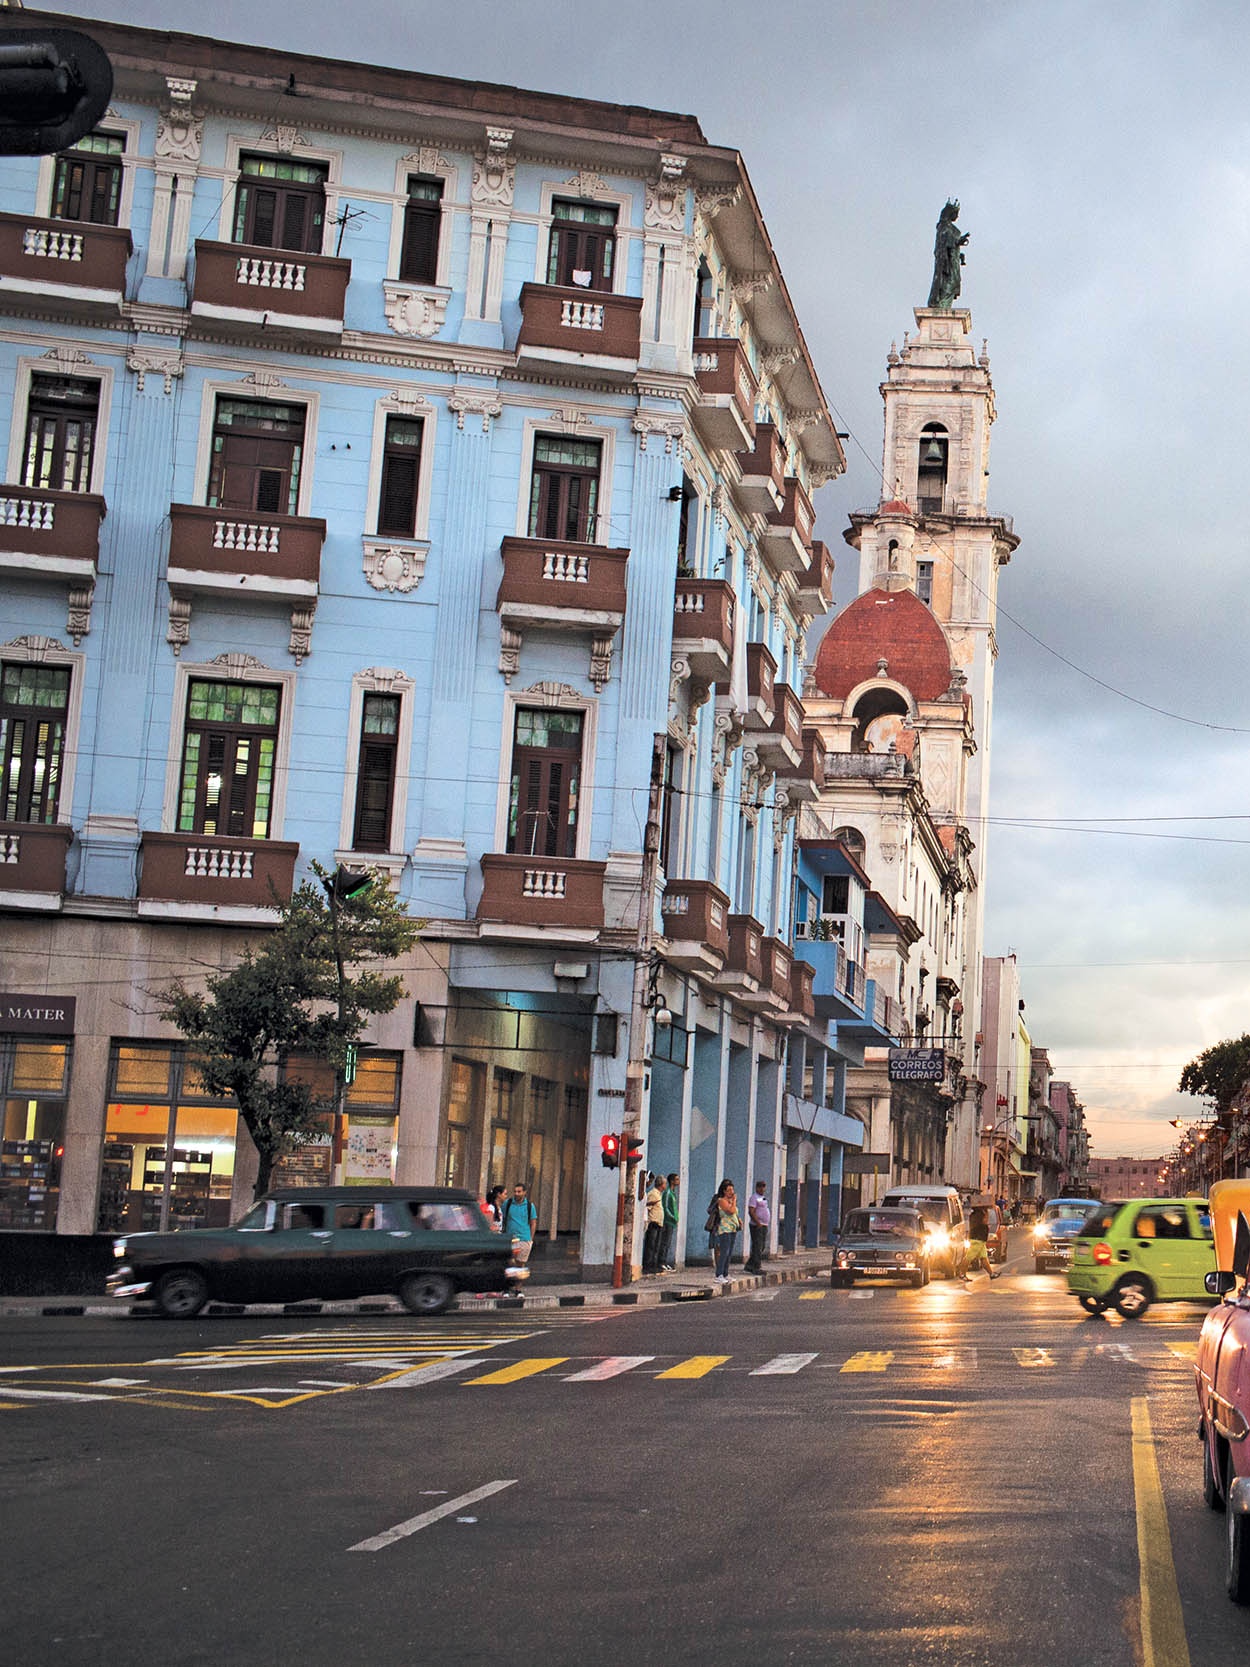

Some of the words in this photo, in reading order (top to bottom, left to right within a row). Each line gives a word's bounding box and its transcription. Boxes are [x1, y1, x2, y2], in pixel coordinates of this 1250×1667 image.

[8, 1008, 65, 1020] MATER
[891, 1060, 943, 1070] CORREOS
[890, 1070, 943, 1080] TELEGRAFO
